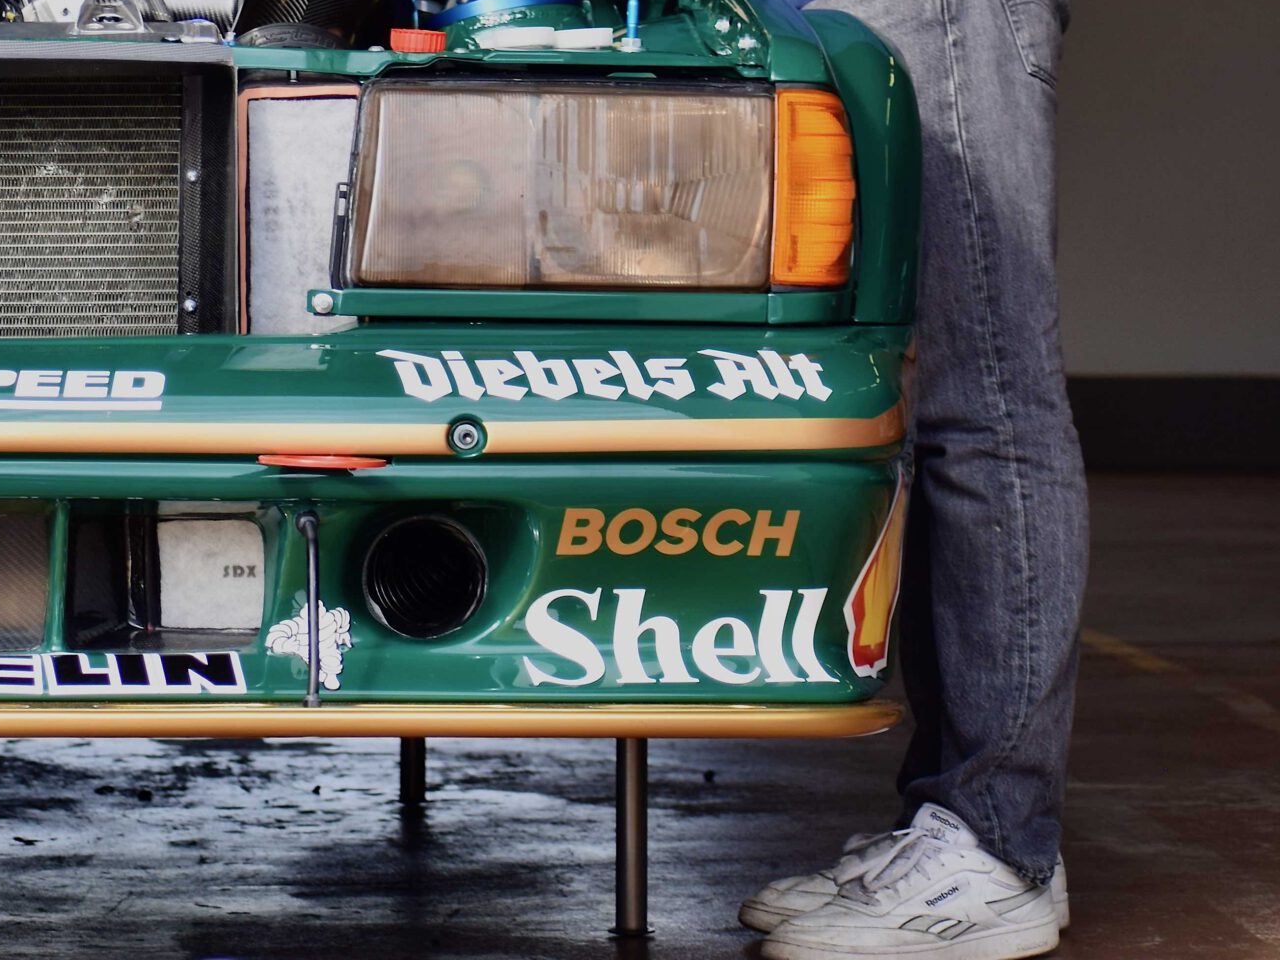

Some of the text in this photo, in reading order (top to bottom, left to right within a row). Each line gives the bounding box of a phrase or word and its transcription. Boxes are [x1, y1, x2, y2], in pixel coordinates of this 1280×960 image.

[375, 348, 833, 403] Diebels Alt
[554, 507, 801, 558] BOSCH
[222, 564, 257, 579] SDX
[522, 586, 841, 687] Shell
[929, 811, 960, 832] Reebok
[925, 886, 960, 907] Reebok
